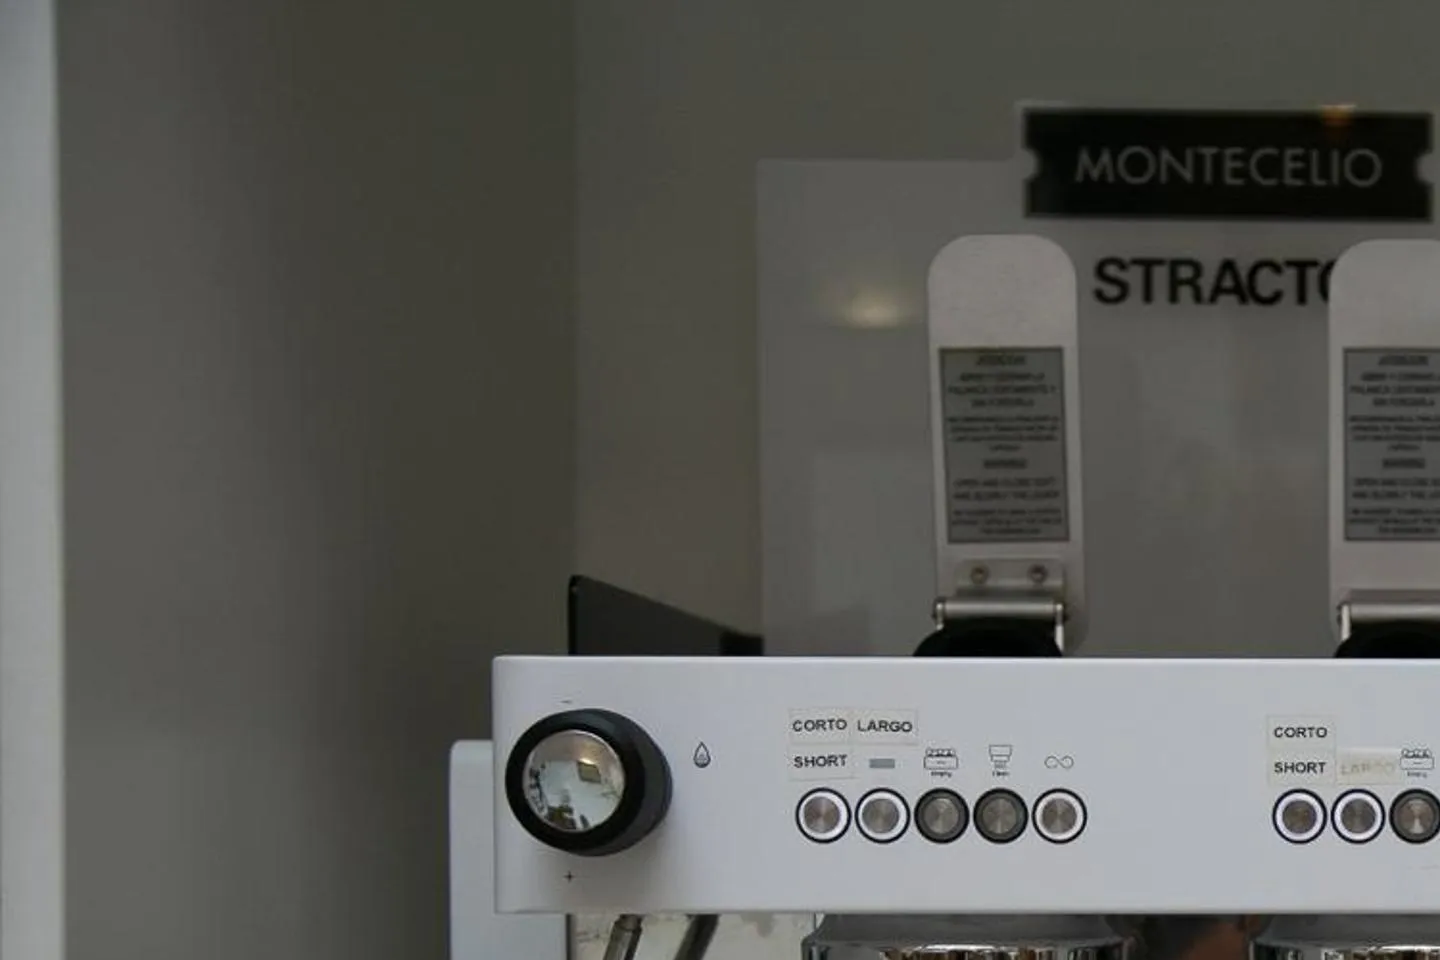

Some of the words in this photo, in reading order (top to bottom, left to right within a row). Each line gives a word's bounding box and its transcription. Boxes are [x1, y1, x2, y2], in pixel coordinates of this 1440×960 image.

[1075, 146, 1383, 187] MONTECELIO
[792, 718, 848, 733] CORTO
[857, 719, 913, 733] LARGO
[1273, 726, 1328, 739] CORTO
[793, 753, 848, 769] SHORT
[1273, 761, 1327, 774] SHORT
